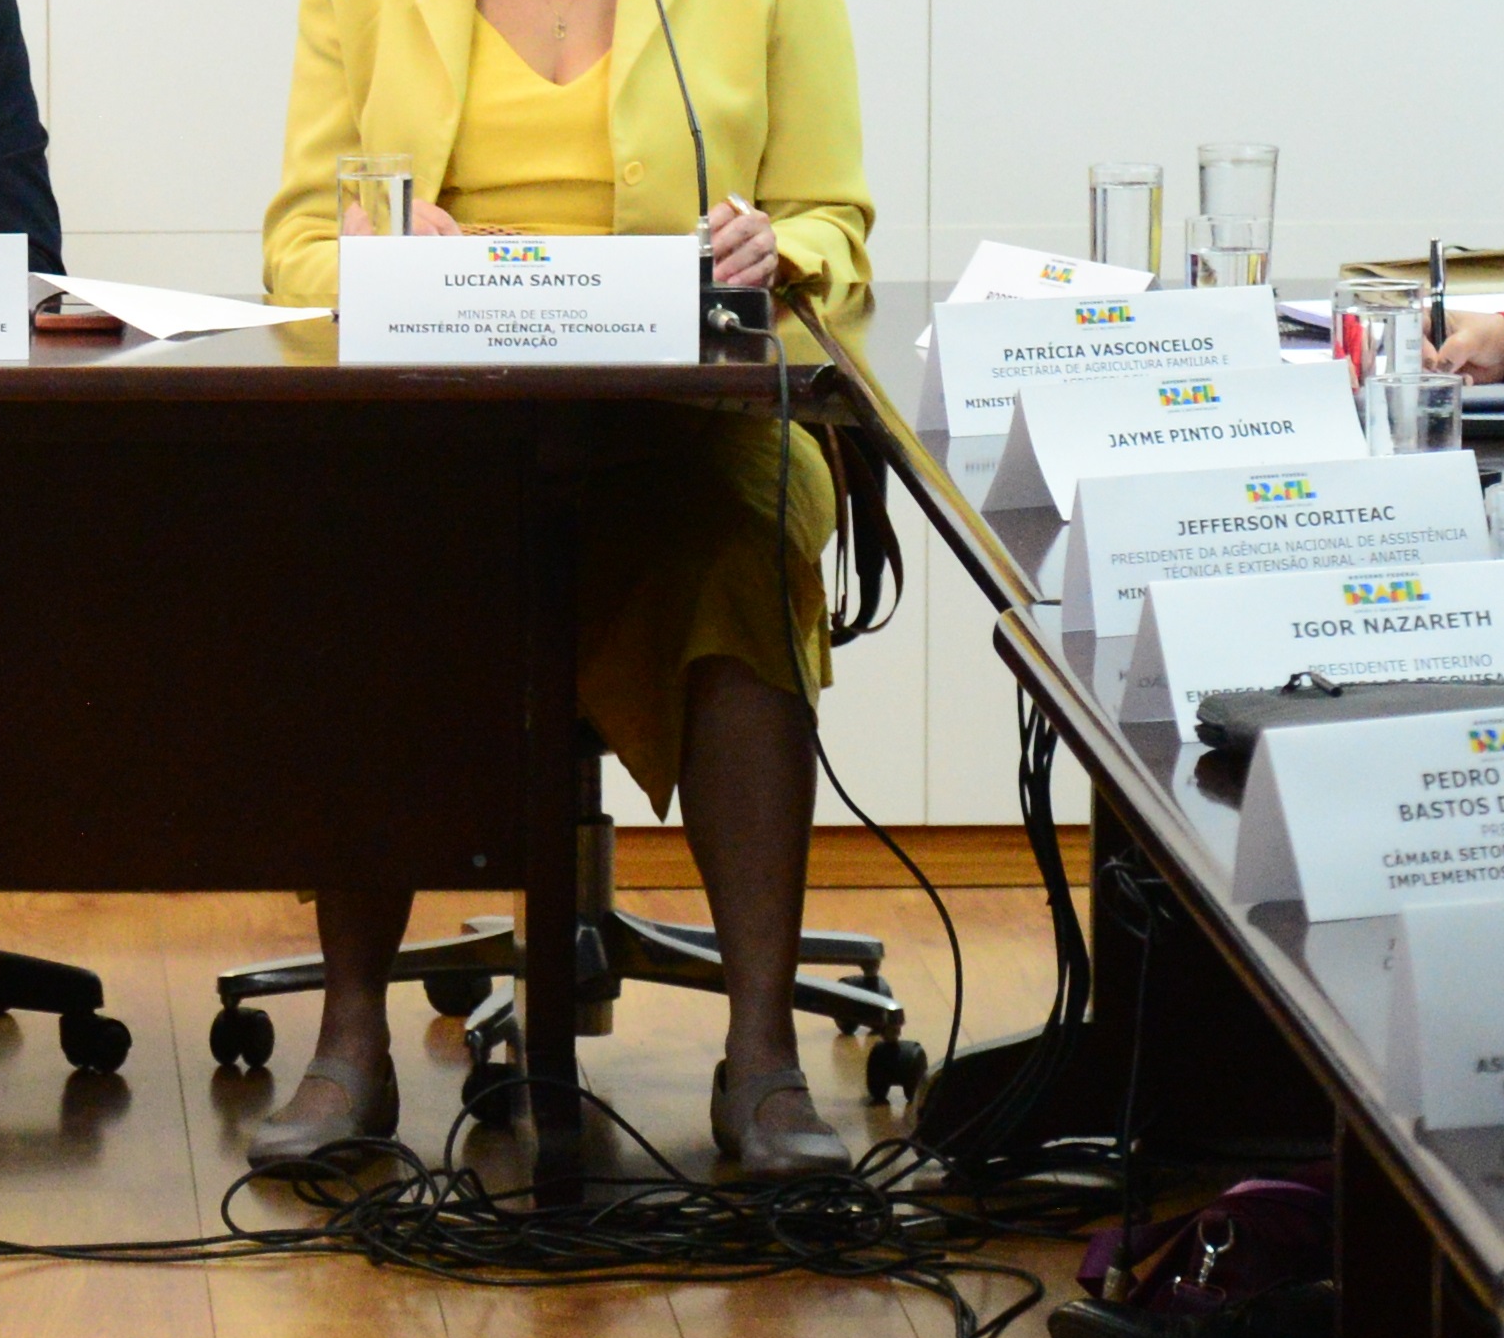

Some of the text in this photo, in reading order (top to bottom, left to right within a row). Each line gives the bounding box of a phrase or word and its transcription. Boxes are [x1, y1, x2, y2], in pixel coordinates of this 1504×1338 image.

[489, 246, 551, 262] BRASIL
[445, 274, 601, 287] LUCIANA SANTOS
[458, 309, 587, 319] MINISTRA DE ESTADO
[1075, 305, 1135, 325] BRASIL
[1, 324, 7, 333] E
[389, 321, 657, 334] MINISTÉRIO DA CIÊNCIA, TECNOLOGIA E
[488, 335, 558, 349] INOVAÇÃO
[1003, 338, 1214, 362] PATRÍCIA VASCONCELOS
[992, 362, 1063, 379] SECRETÁRIA
[1065, 363, 1080, 374] DE
[1085, 358, 1163, 374] AGRICULTURA
[1166, 356, 1220, 369] FAMILIAR
[1222, 355, 1230, 365] E
[1158, 384, 1221, 406] BRASIL
[1108, 419, 1295, 448] JAYME PINTO JÚNIOR
[1245, 478, 1317, 503] BRASIL
[1178, 506, 1396, 536] JEFFERSON CORITEAC
[1111, 527, 1468, 566] PRESIDENTE DA AGÊNCIA NACIONAL DE ASSISTÊNCIA
[1164, 563, 1222, 579] TÉCNICA
[1226, 564, 1234, 574] E
[1239, 557, 1308, 575] EXTENSÃO
[1312, 554, 1355, 569] RURAL
[1343, 580, 1430, 606] BRASIL
[1292, 610, 1492, 639] IGOR NAZARETH
[1308, 653, 1492, 676] PRESIDENTE INTERINO
[1422, 768, 1500, 791] PEDRO
[1398, 797, 1490, 822] BASTOS
[1382, 850, 1453, 868] CÂMARA
